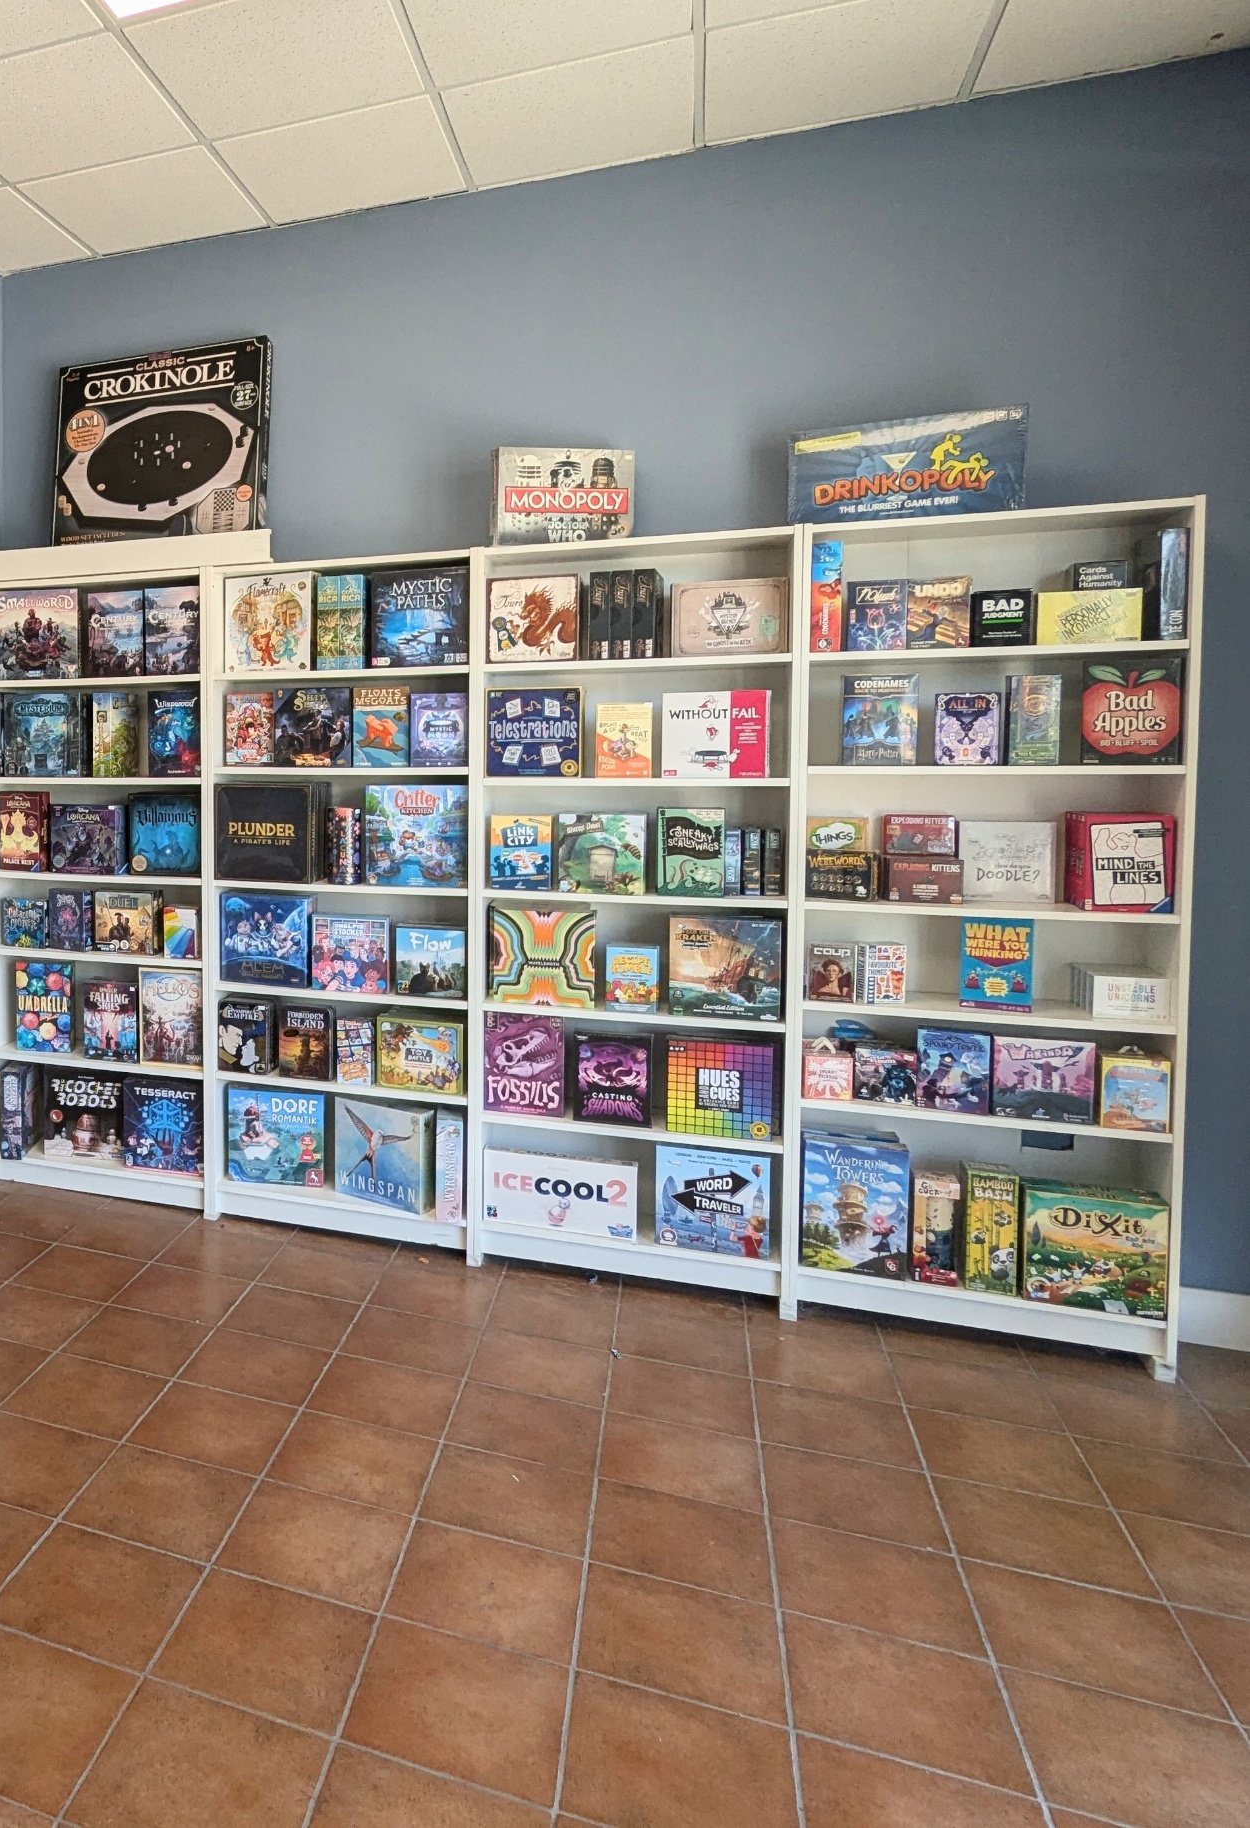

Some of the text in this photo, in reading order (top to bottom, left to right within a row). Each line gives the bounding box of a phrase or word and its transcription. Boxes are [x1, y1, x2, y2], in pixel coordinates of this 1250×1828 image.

[135, 356, 186, 372] CLASSIC
[84, 360, 235, 400] CROKINOLE
[814, 468, 996, 506] DRINKOPOLY
[510, 490, 624, 511] MONOPOLY
[840, 506, 856, 514] THE
[857, 501, 902, 512] BLURRIEST
[904, 498, 932, 508] GAME
[934, 496, 958, 505] EVER!
[548, 530, 586, 542] WHO
[1079, 566, 1107, 574] Cards
[1078, 580, 1123, 588] Humanity
[1079, 573, 1114, 582] Against
[389, 578, 452, 596] MYSTIC
[318, 595, 338, 604] RICA
[341, 593, 360, 602] RICA
[397, 594, 446, 610] PATHS
[982, 598, 1024, 612] BAD
[90, 614, 140, 628] CENTURY
[149, 609, 200, 624] CENTURY
[982, 611, 1024, 619] JUDGMENT
[854, 680, 909, 689] CODENAMES
[361, 689, 401, 698] FLOATS
[1106, 690, 1154, 711] Bad
[20, 704, 64, 714] MYSTERIUM
[948, 700, 986, 708] ALL IN
[670, 708, 728, 720] WITHOUT
[488, 720, 577, 740] Telestrations
[1094, 711, 1166, 736] Apples
[394, 789, 440, 809] Critter
[66, 812, 100, 822] LORCANA
[136, 806, 197, 827] Villainous
[228, 822, 295, 837] PLUNDER
[670, 826, 712, 842] SNEAKY
[507, 835, 534, 846] CITY
[668, 838, 719, 851] SCALLYWAGS
[809, 853, 867, 868] WEREWORDS
[1098, 860, 1154, 870] MIND THE
[931, 863, 960, 873] KITTENS
[976, 868, 1040, 883] DOODLE?
[1116, 872, 1159, 884] LINES
[675, 934, 716, 942] KRAKEN
[965, 923, 1030, 941] WHAT
[409, 932, 452, 952] Flow
[966, 939, 1030, 952] WERE YOU
[966, 948, 1030, 960] THINKING?
[18, 995, 68, 1013] UMBRELLA
[88, 992, 130, 1004] FALLING
[97, 1002, 120, 1012] SKIES
[287, 1010, 324, 1020] FORBIDDEN
[287, 1018, 324, 1030] ISLAND
[699, 1068, 740, 1088] HUES
[134, 1086, 196, 1100] TESSERACT
[487, 1076, 560, 1108] FOSSILIS
[592, 1092, 634, 1101] CASTING
[710, 1086, 740, 1102] CUES
[271, 1098, 318, 1114] DORF
[582, 1099, 644, 1122] SHADOWS
[272, 1114, 318, 1125] ROMANTIK
[444, 1142, 456, 1203] WYRMSPAN
[832, 1166, 884, 1185] TOWERS
[339, 1170, 416, 1204] WINGSPAN
[696, 1178, 732, 1193] WORD
[972, 1178, 1014, 1189] BAMBOO
[974, 1188, 1013, 1201] BASH
[694, 1196, 741, 1214] TRAVELER
